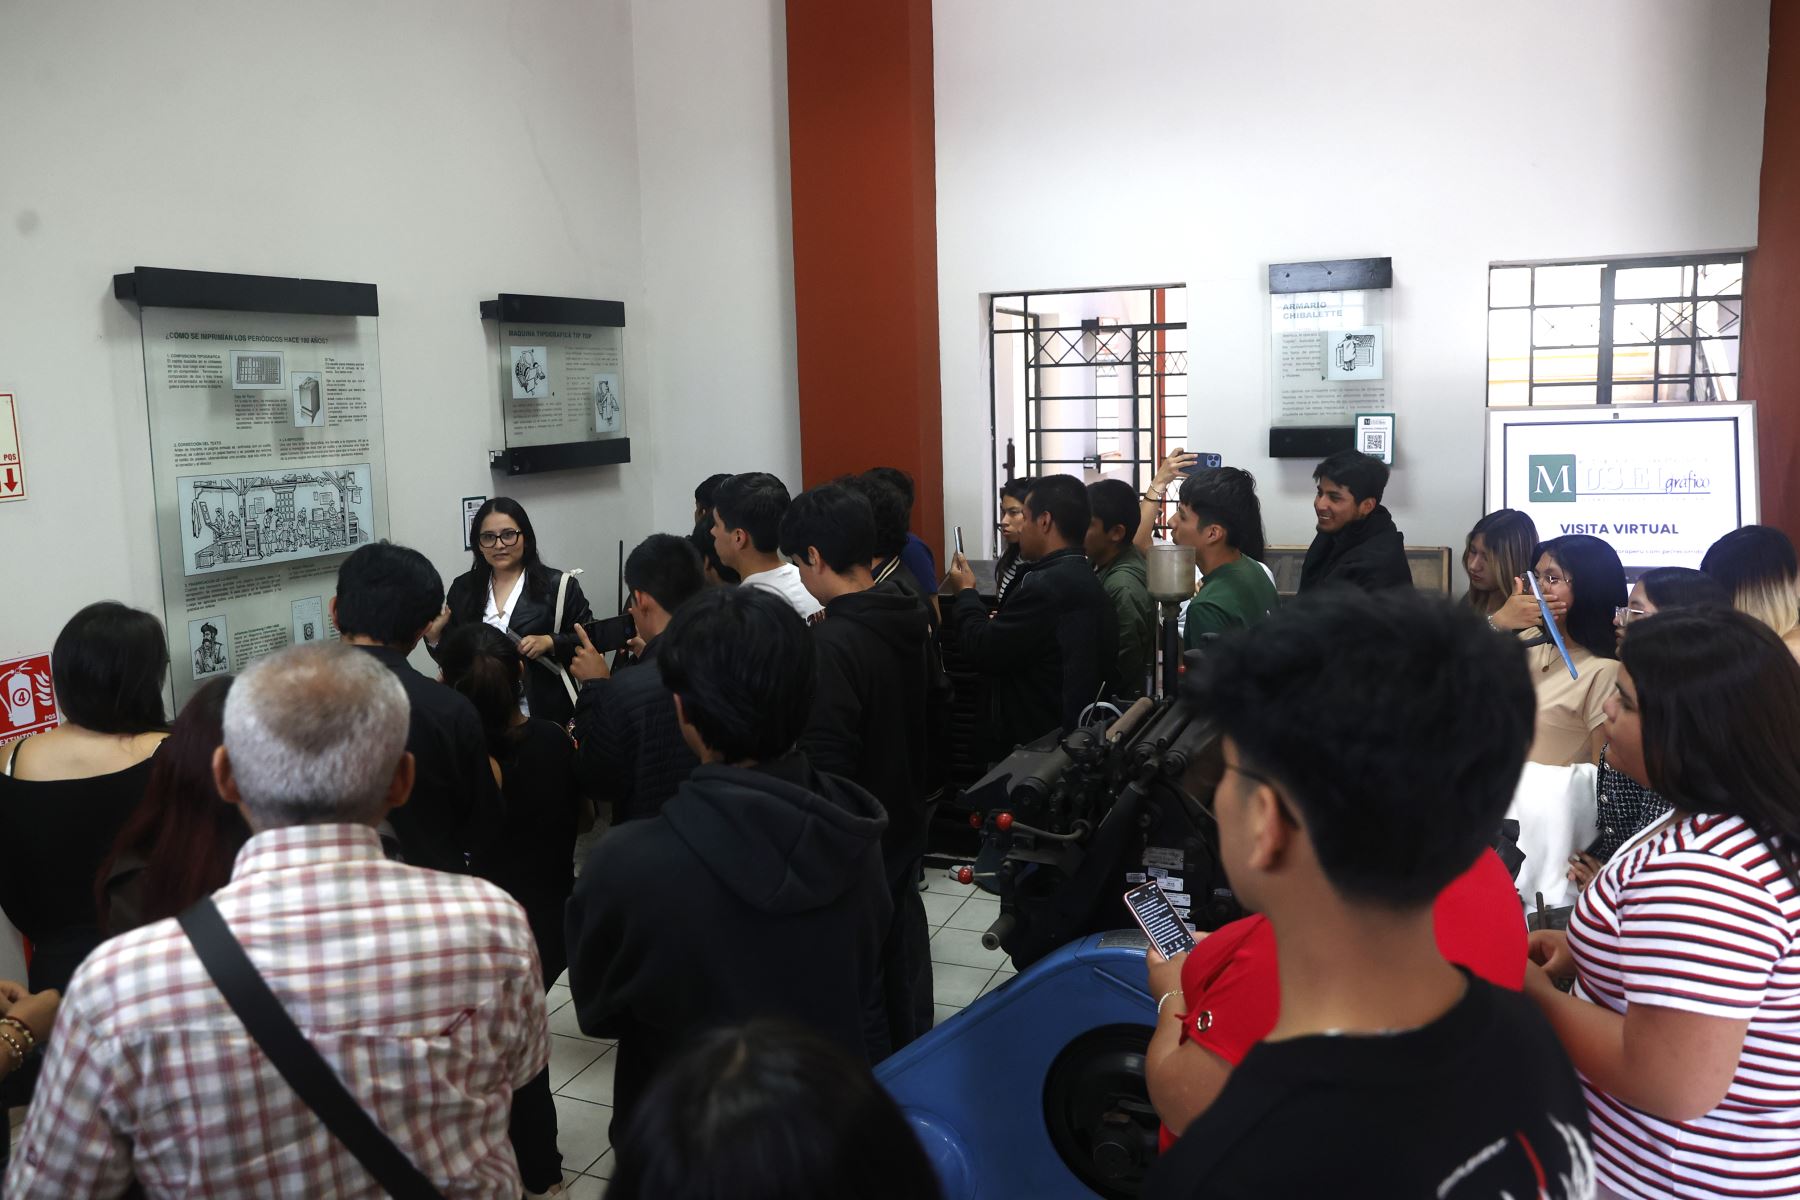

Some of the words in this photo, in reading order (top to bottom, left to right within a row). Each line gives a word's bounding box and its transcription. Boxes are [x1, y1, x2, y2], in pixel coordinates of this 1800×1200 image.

[1282, 301, 1327, 310] ARMARIO
[1283, 310, 1343, 320] CHIBALETTE
[191, 332, 200, 340] SE
[234, 334, 247, 342] LOS
[283, 335, 299, 344] HACE
[1560, 523, 1609, 534] VISITA
[1613, 523, 1679, 534] VIRTUAL
[18, 691, 26, 703] 4
